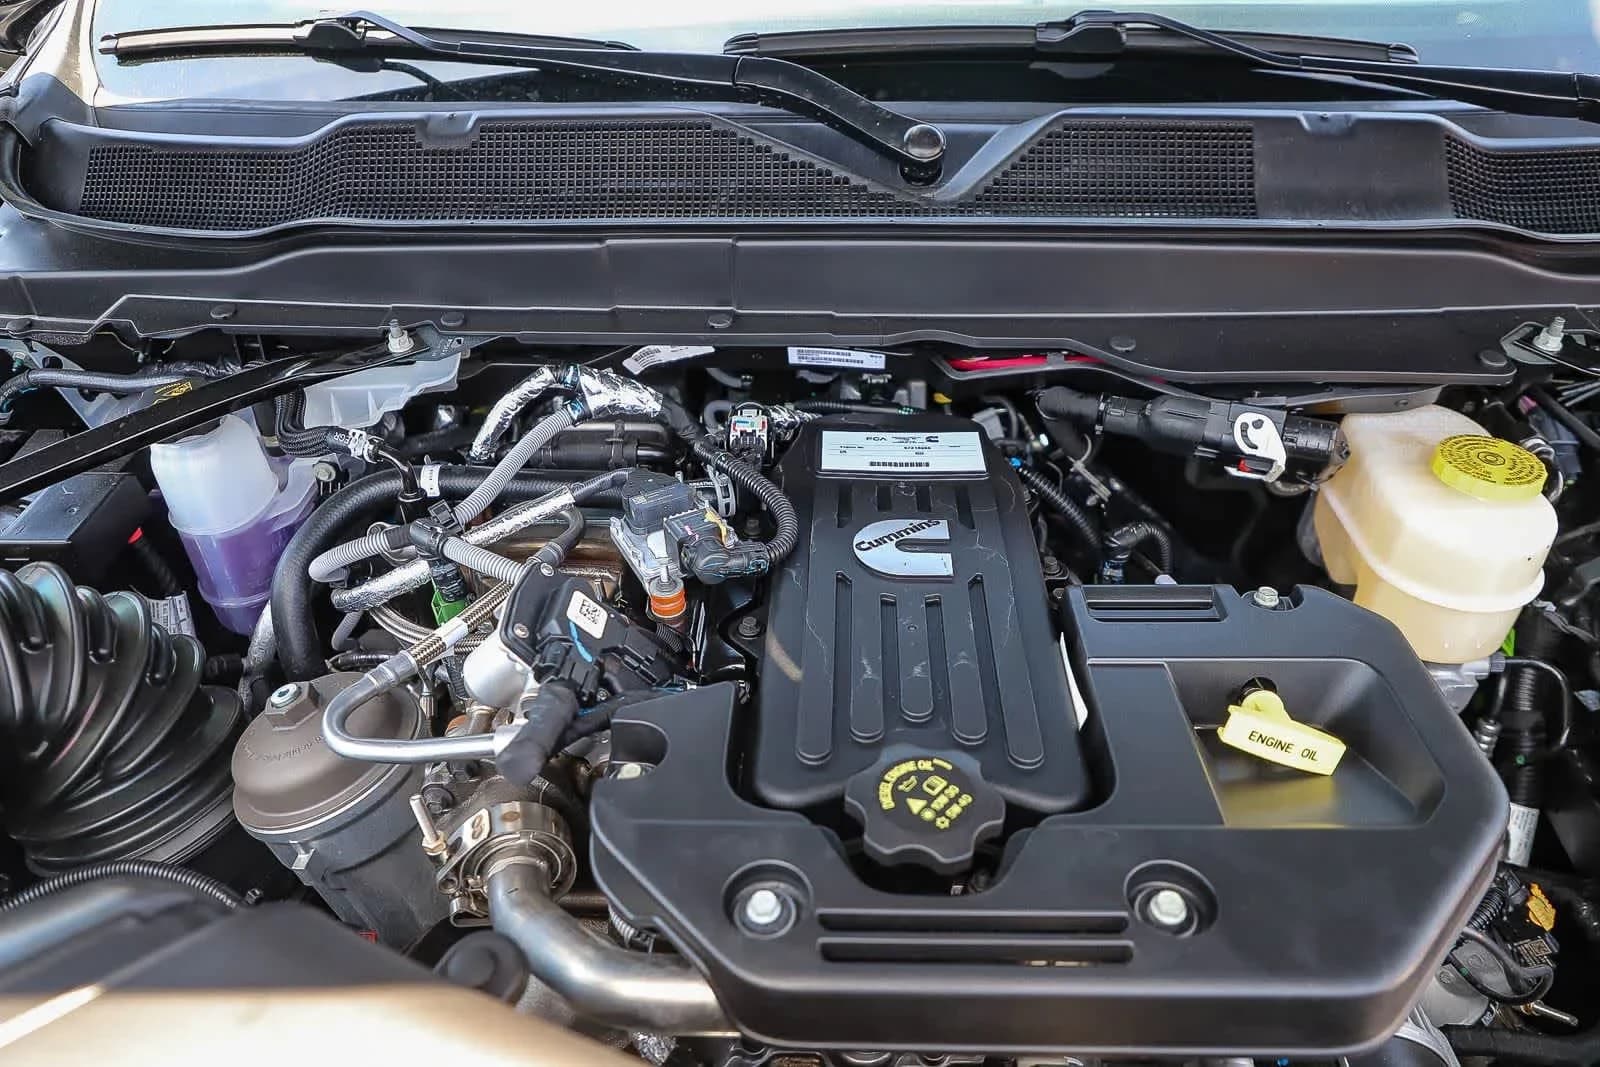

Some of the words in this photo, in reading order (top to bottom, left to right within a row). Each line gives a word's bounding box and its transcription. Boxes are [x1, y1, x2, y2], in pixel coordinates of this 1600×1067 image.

[855, 519, 941, 552] Cummins
[1248, 730, 1295, 754] ENGINE
[1301, 748, 1319, 762] OIL
